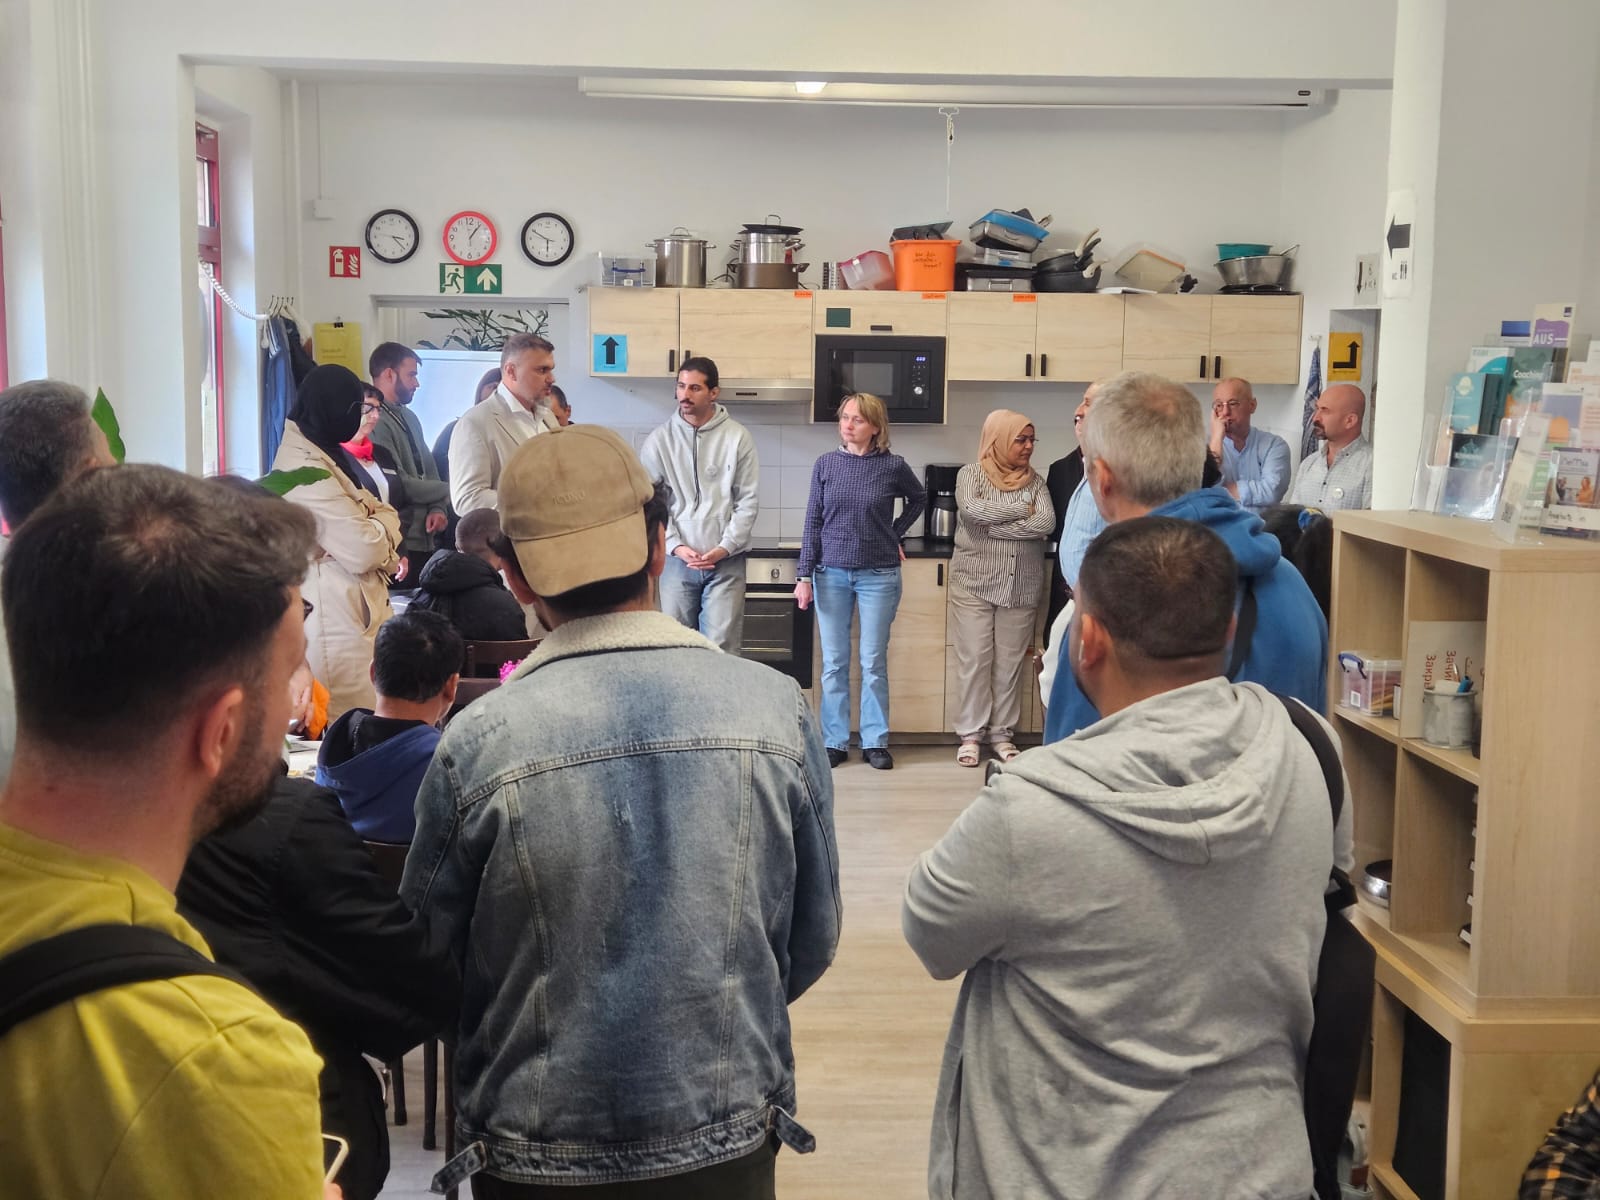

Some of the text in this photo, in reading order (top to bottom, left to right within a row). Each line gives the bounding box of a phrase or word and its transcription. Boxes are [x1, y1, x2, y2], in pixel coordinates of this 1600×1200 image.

[465, 217, 474, 226] 12
[466, 252, 473, 260] 6
[1533, 333, 1554, 345] AUS
